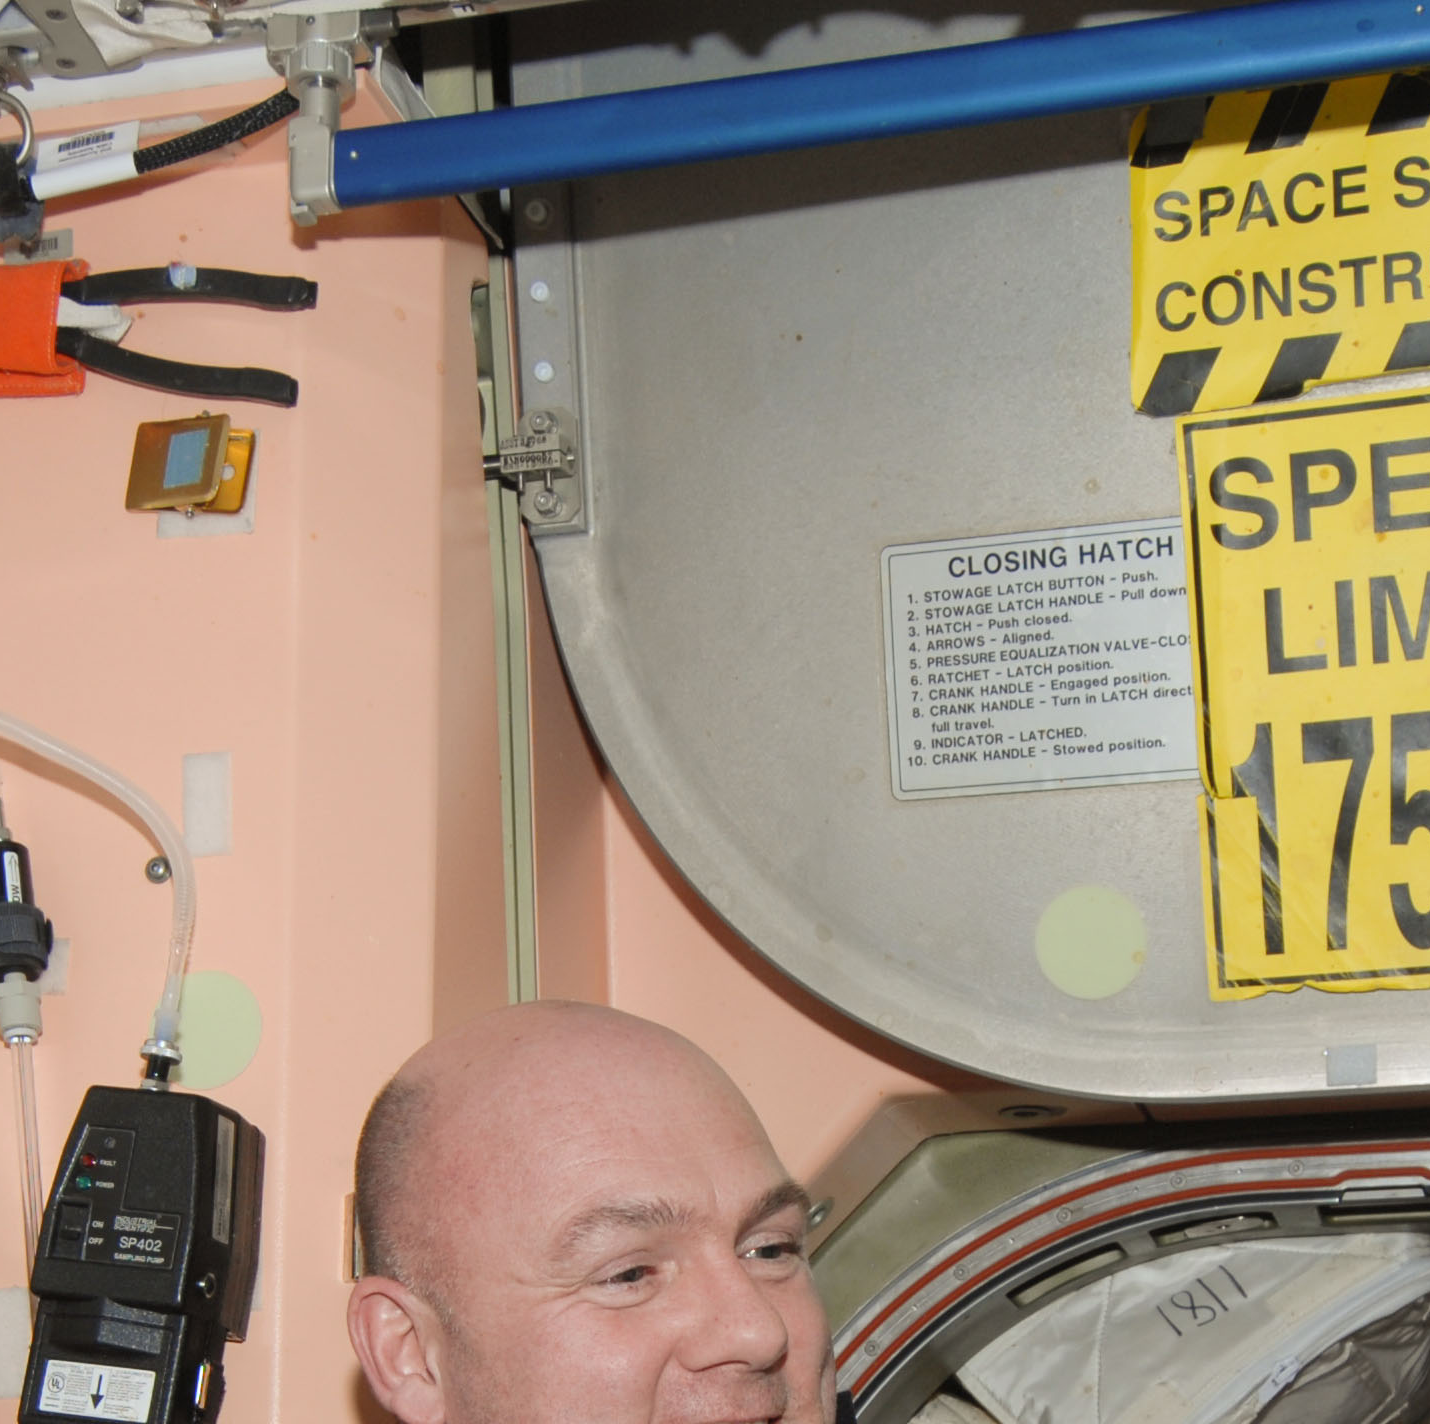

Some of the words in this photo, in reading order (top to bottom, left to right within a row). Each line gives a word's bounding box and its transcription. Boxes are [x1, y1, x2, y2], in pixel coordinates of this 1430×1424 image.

[1153, 165, 1370, 243] SPACE
[949, 546, 1067, 577] CLOSING
[1079, 536, 1173, 565] HATCH
[907, 594, 918, 605] 1.
[924, 586, 992, 603] STOWAGE
[997, 581, 1043, 596] LATCH
[1049, 575, 1104, 591] BUTTON
[1122, 571, 1158, 584] Push.
[907, 610, 919, 622] 2.
[925, 603, 993, 620] STOWAGE
[998, 598, 1043, 613] LATCH
[1049, 593, 1103, 608] HANDLE
[1122, 588, 1144, 601] Pull
[1150, 586, 1186, 598] down
[908, 626, 920, 638] 3.
[926, 622, 971, 635] HATCH
[988, 618, 1019, 630] Push
[1024, 613, 1072, 626] closed.
[909, 642, 920, 653] 4.
[927, 636, 985, 651] ARROWS
[1003, 630, 1054, 647] Aligned.
[910, 659, 921, 670] 5.
[927, 652, 995, 668] PRESSURE
[1001, 643, 1099, 661] EQUALIZATION
[1104, 635, 1191, 652] VALVE-CLO
[911, 675, 922, 686] 6.
[928, 670, 989, 685] RATCHET
[1007, 663, 1052, 677] LATCH
[1058, 659, 1114, 676] position.
[912, 691, 923, 702] 7.
[929, 687, 974, 700] CRANK
[980, 681, 1033, 696] HANDLE
[1051, 674, 1108, 691] Engaged
[1114, 671, 1171, 687] position.
[913, 707, 924, 718] 8.
[930, 703, 975, 717] CRANK
[981, 698, 1034, 713] HANDLE
[1051, 694, 1079, 707] Turn
[1086, 693, 1096, 704] in
[1102, 689, 1148, 703] LATCH
[1153, 685, 1193, 698] direct
[914, 740, 925, 750] 9.
[931, 733, 1003, 749] INDICATOR
[1020, 727, 1087, 742] LATCHED.
[931, 721, 950, 733] full
[955, 718, 994, 731] travel.
[908, 756, 927, 767] 10.
[932, 751, 977, 765] CRANK
[984, 746, 1036, 761] HANDLE
[1053, 741, 1103, 756] Stowed
[1109, 737, 1166, 753] position.
[89, 1237, 103, 1245] OFF
[119, 1236, 162, 1252] SP402
